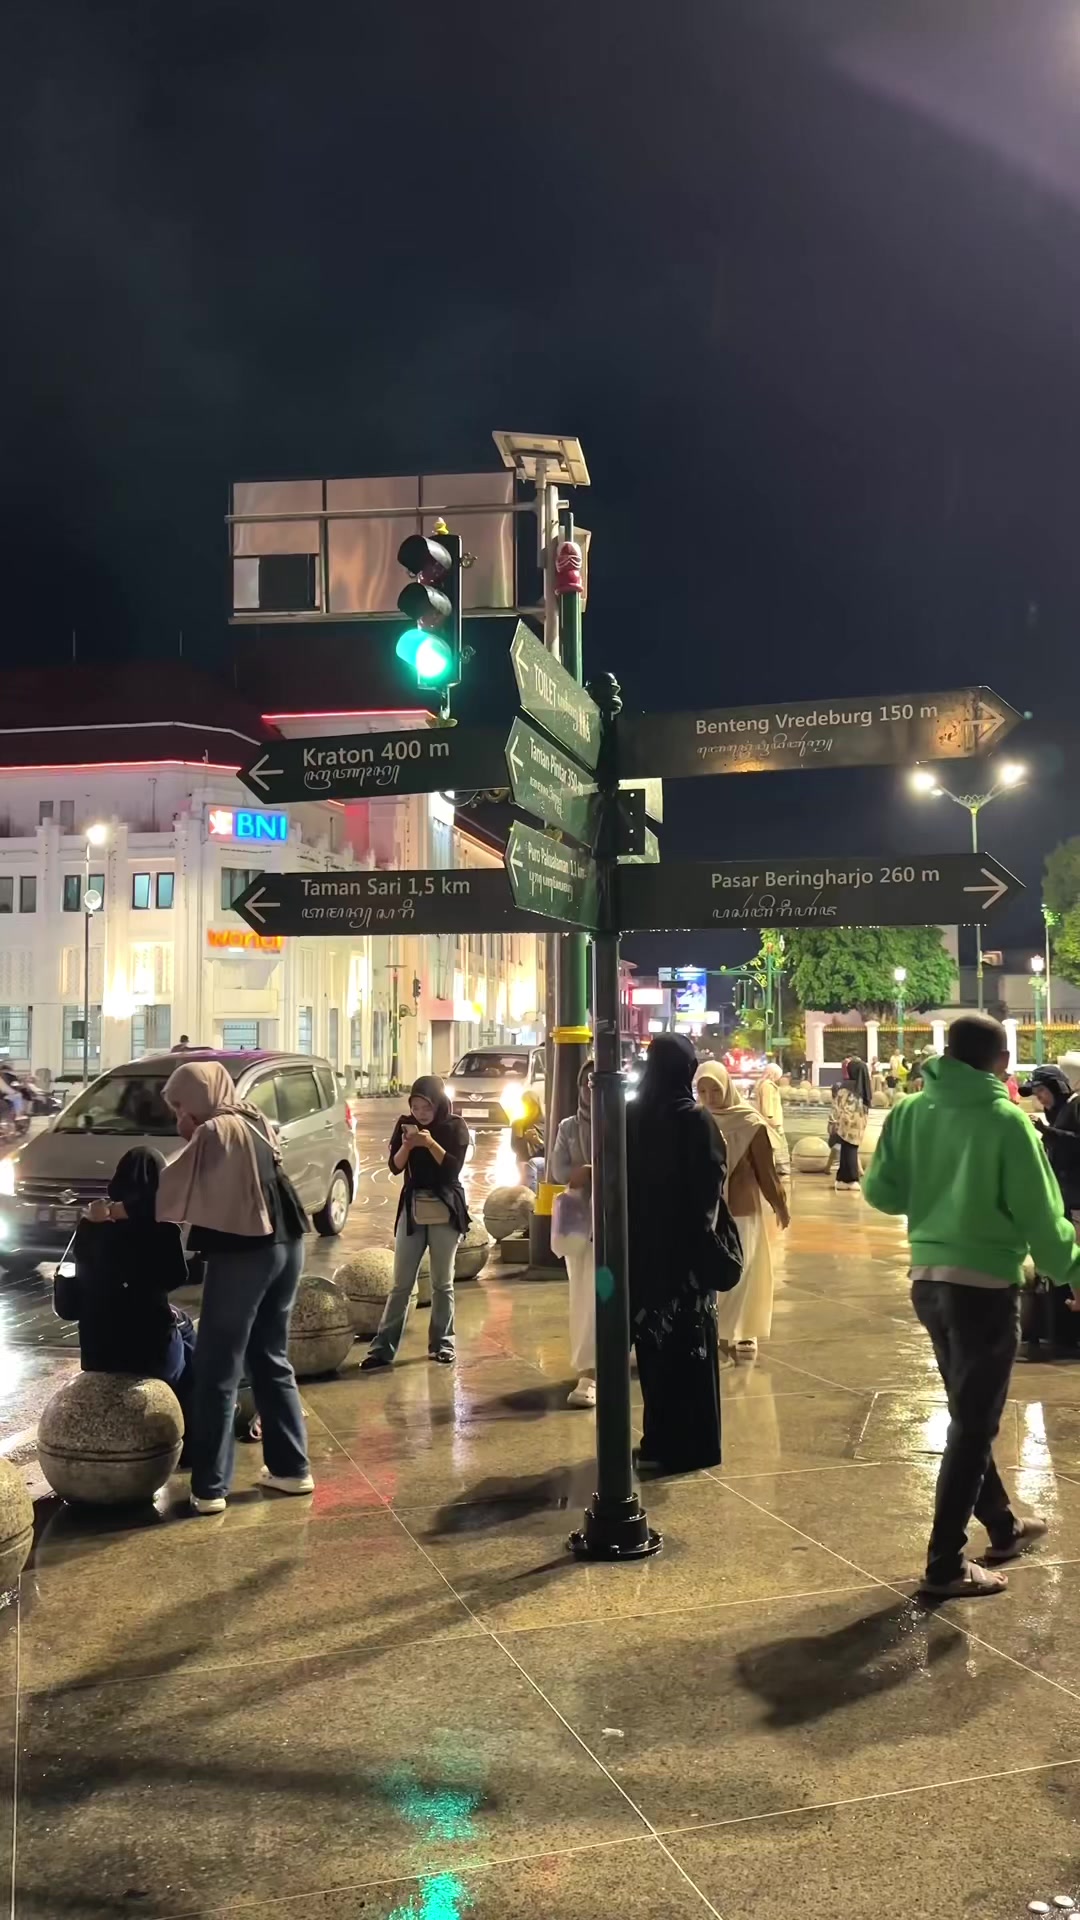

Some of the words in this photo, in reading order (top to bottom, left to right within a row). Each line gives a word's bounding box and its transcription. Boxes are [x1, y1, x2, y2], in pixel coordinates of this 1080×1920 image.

[533, 663, 557, 708] TOILET
[695, 716, 769, 735] Benteng
[776, 709, 872, 729] Vredeburg
[879, 704, 913, 722] 150
[920, 705, 938, 719] m
[303, 747, 374, 767] Kraton
[381, 740, 421, 760] 400
[429, 742, 450, 758] m
[530, 737, 550, 771] Taman
[236, 811, 287, 840] BNI
[301, 878, 361, 896] Taman
[367, 877, 401, 895] Sari
[408, 877, 435, 897] 1,5
[442, 876, 470, 894] km
[711, 872, 759, 889] Pasar
[765, 868, 873, 890] Beringharjo
[880, 866, 915, 884] 260
[922, 868, 940, 883] m
